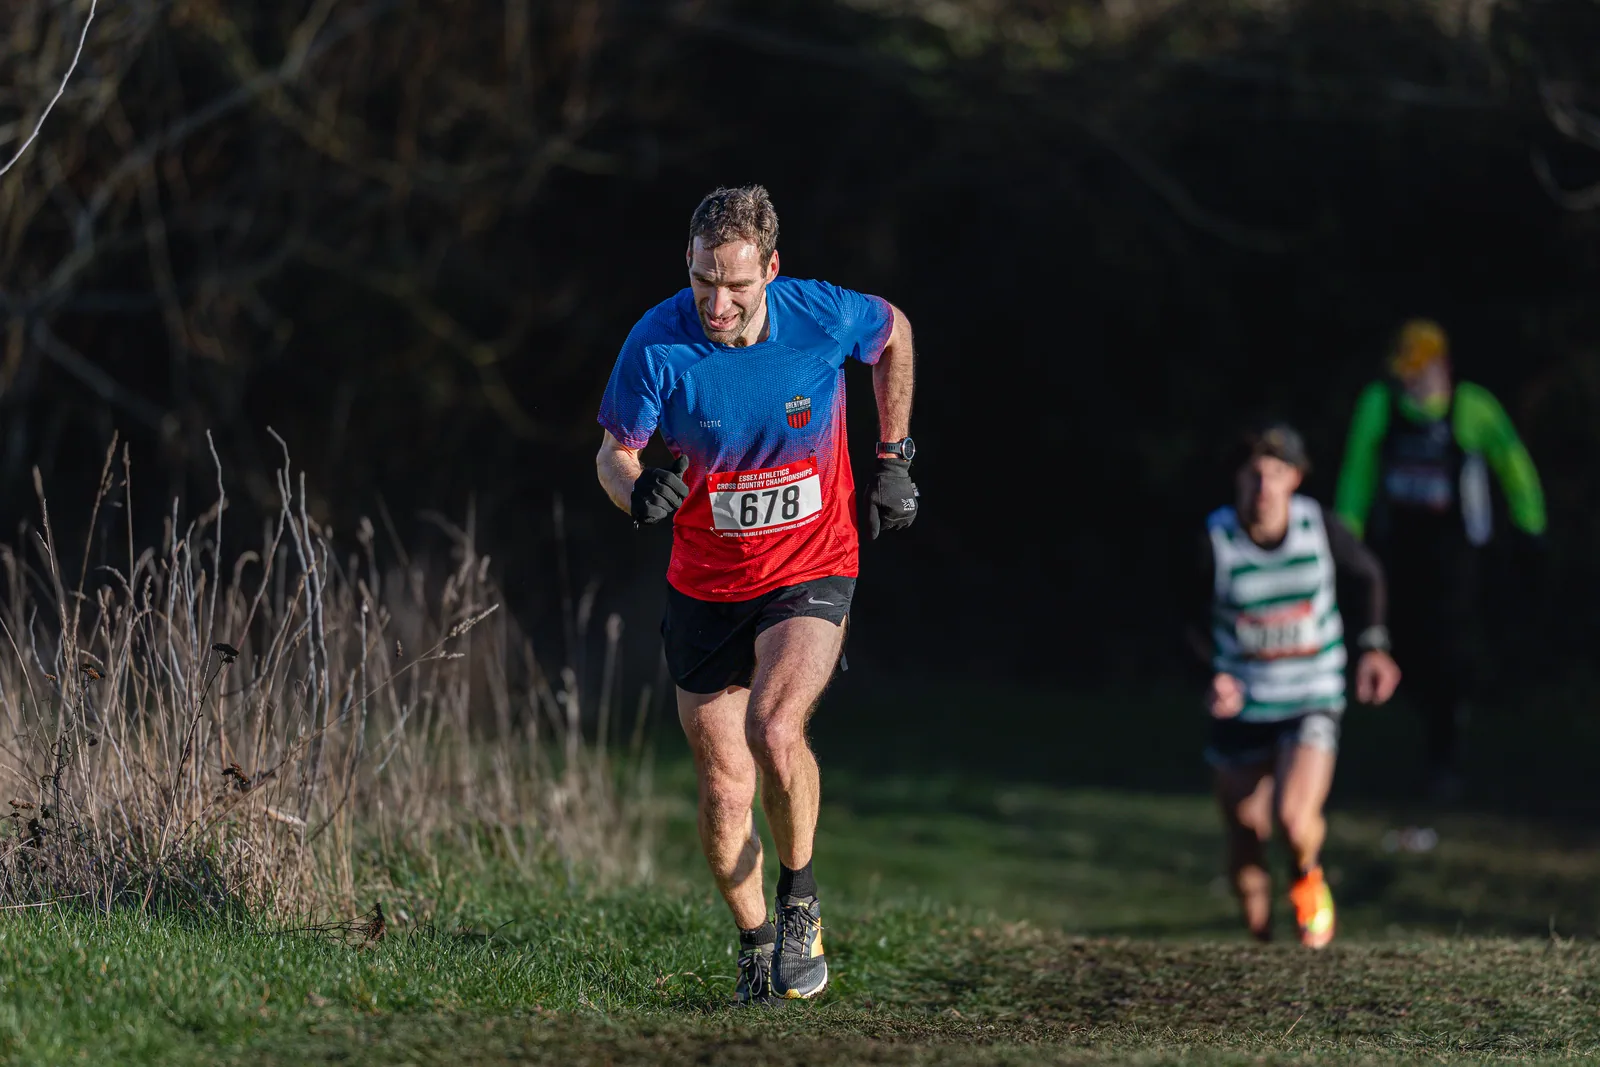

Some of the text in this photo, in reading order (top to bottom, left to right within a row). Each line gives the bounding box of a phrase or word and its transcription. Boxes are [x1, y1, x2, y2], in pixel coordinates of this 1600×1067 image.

[700, 420, 721, 428] TACTIC
[737, 481, 765, 490] COUNTRY
[766, 468, 813, 487] CHAMPIONSHIPS
[739, 468, 790, 482] ESSEX ATHLETICS
[740, 485, 800, 527] 678
